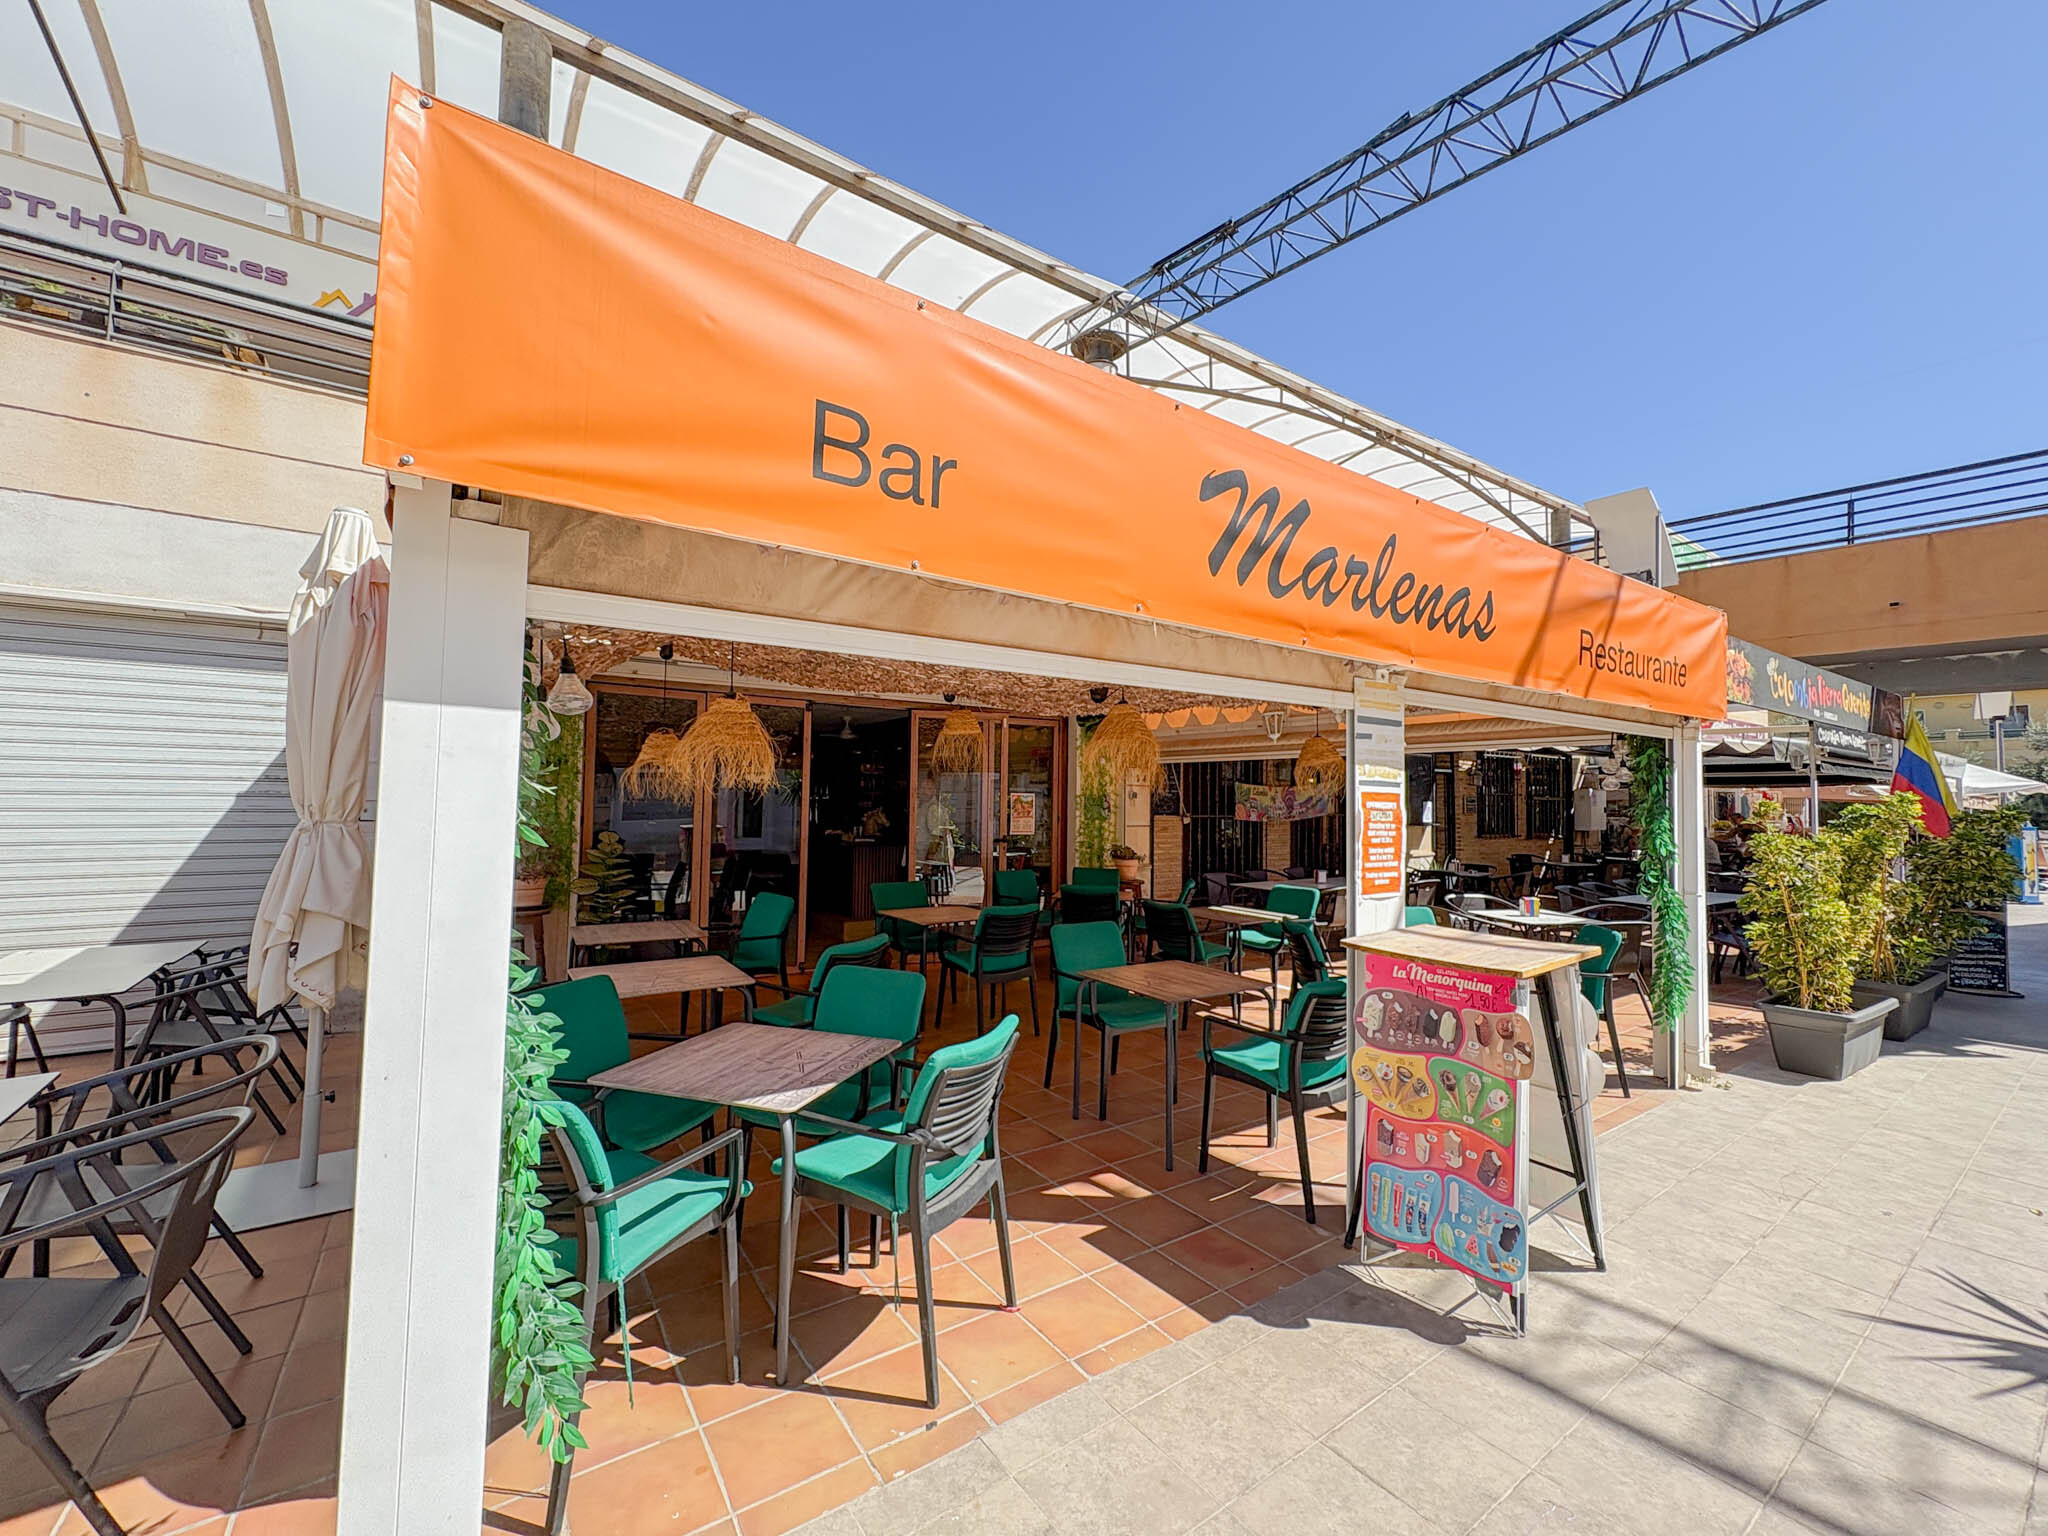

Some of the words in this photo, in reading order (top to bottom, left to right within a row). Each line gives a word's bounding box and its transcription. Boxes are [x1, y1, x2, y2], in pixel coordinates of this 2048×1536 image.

[812, 398, 958, 509] Bar
[1199, 468, 1497, 642] Marlenas
[1579, 628, 1688, 688] Restaurante
[1406, 963, 1493, 996] Menorquina
